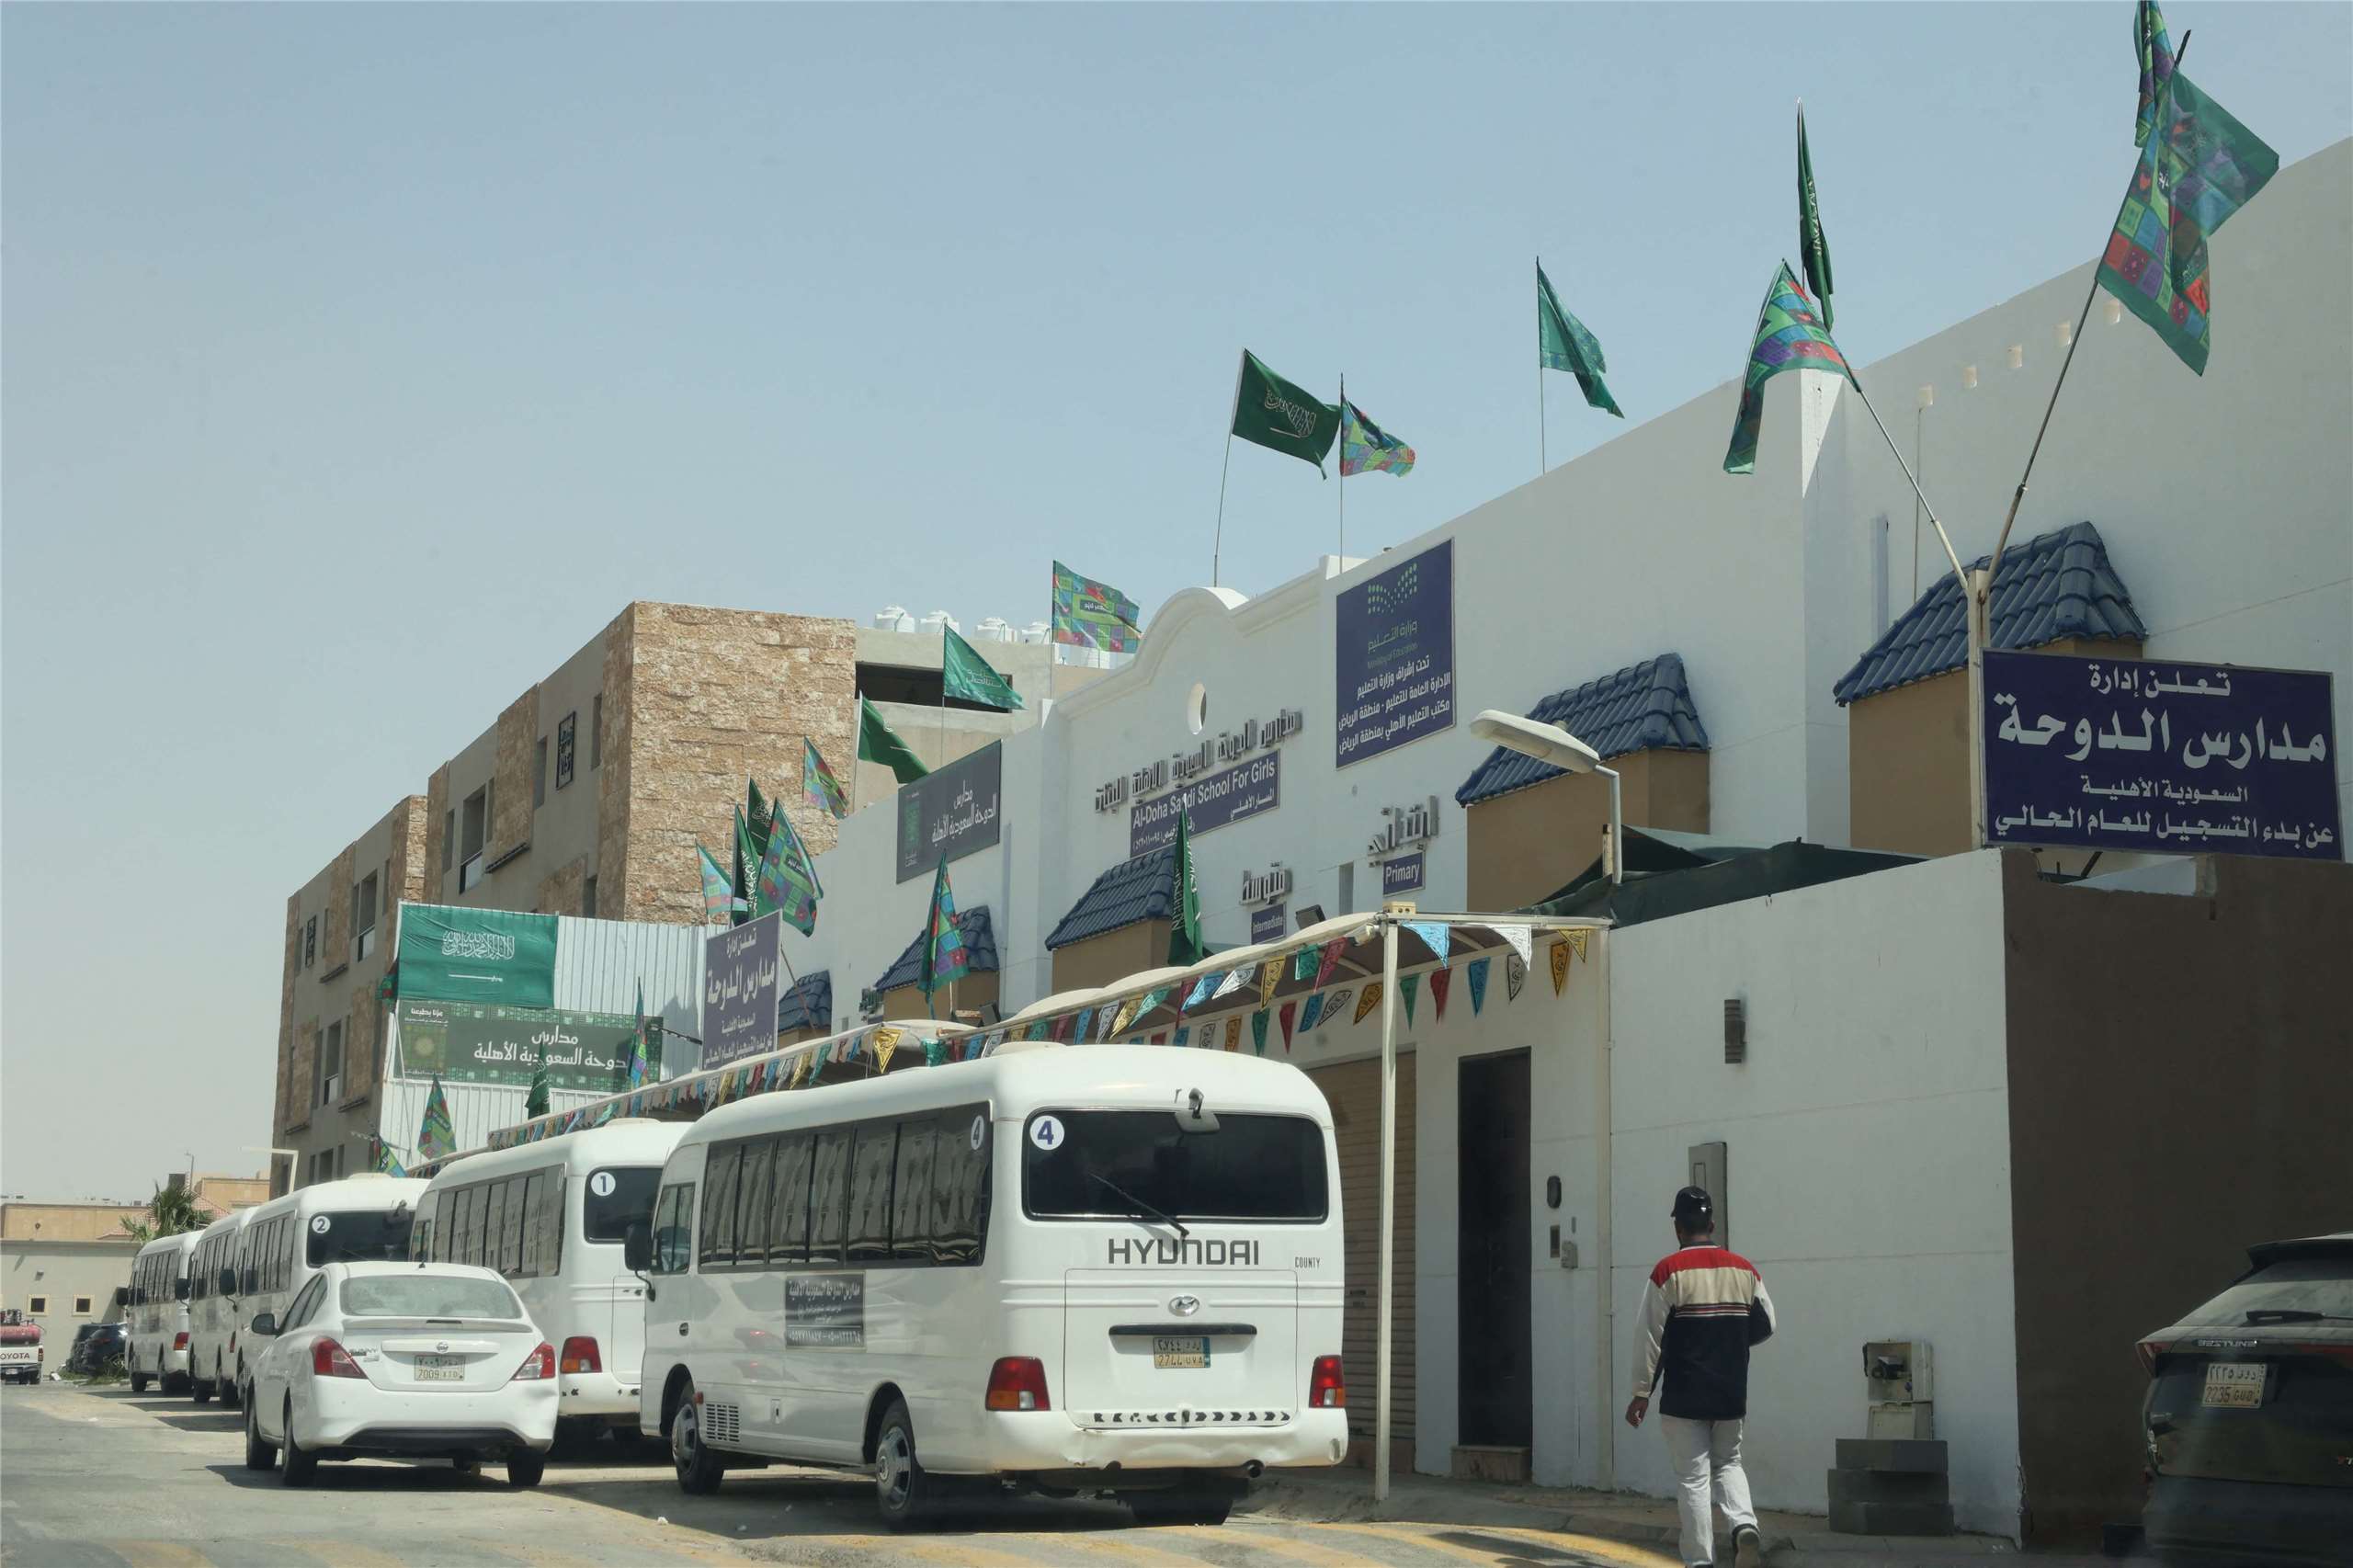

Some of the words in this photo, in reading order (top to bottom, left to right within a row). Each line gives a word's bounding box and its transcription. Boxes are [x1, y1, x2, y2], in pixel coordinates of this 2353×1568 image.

[1415, 654, 1430, 672] تحت
[1357, 676, 1378, 700] التعليم
[1380, 672, 1394, 690] وزارة
[2088, 664, 2140, 699] إدارة
[2144, 671, 2231, 699] تعلن
[1338, 710, 1358, 732] الرياض
[1406, 706, 1429, 731] التعليم
[1430, 699, 1450, 720] مكتب
[1993, 692, 2170, 762] الدوحة
[1339, 733, 1358, 755] الرياض
[2183, 716, 2327, 770] مدارس
[954, 779, 973, 809] مدارس
[1133, 801, 1167, 829] Al-Doha
[1170, 788, 1195, 814] Sadi
[1198, 778, 1230, 805] School
[1233, 770, 1248, 791] For
[1251, 758, 1275, 783] Girls
[2080, 774, 2158, 801] الأهلية
[2162, 778, 2248, 806] السعودية
[1995, 805, 2082, 836] الحالي
[2087, 809, 2151, 835] للعام
[2156, 812, 2257, 842] التسجيل
[2263, 821, 2301, 850] بدء
[2305, 822, 2334, 848] عن
[1385, 864, 1420, 884] Primary
[708, 963, 743, 1010] الدوحة
[743, 956, 775, 1004] مدارس
[530, 1025, 579, 1045] مدارس
[473, 1041, 517, 1062] الأهلية
[584, 1050, 628, 1070] دوحة
[1037, 1119, 1054, 1145] 4
[600, 1176, 607, 1193] 1
[317, 1218, 326, 1232] 2
[1108, 1238, 1259, 1266] HYUNDAI
[1295, 1256, 1321, 1268] COUNTY
[0, 1352, 30, 1360] OYOTA
[419, 1369, 439, 1379] 7009
